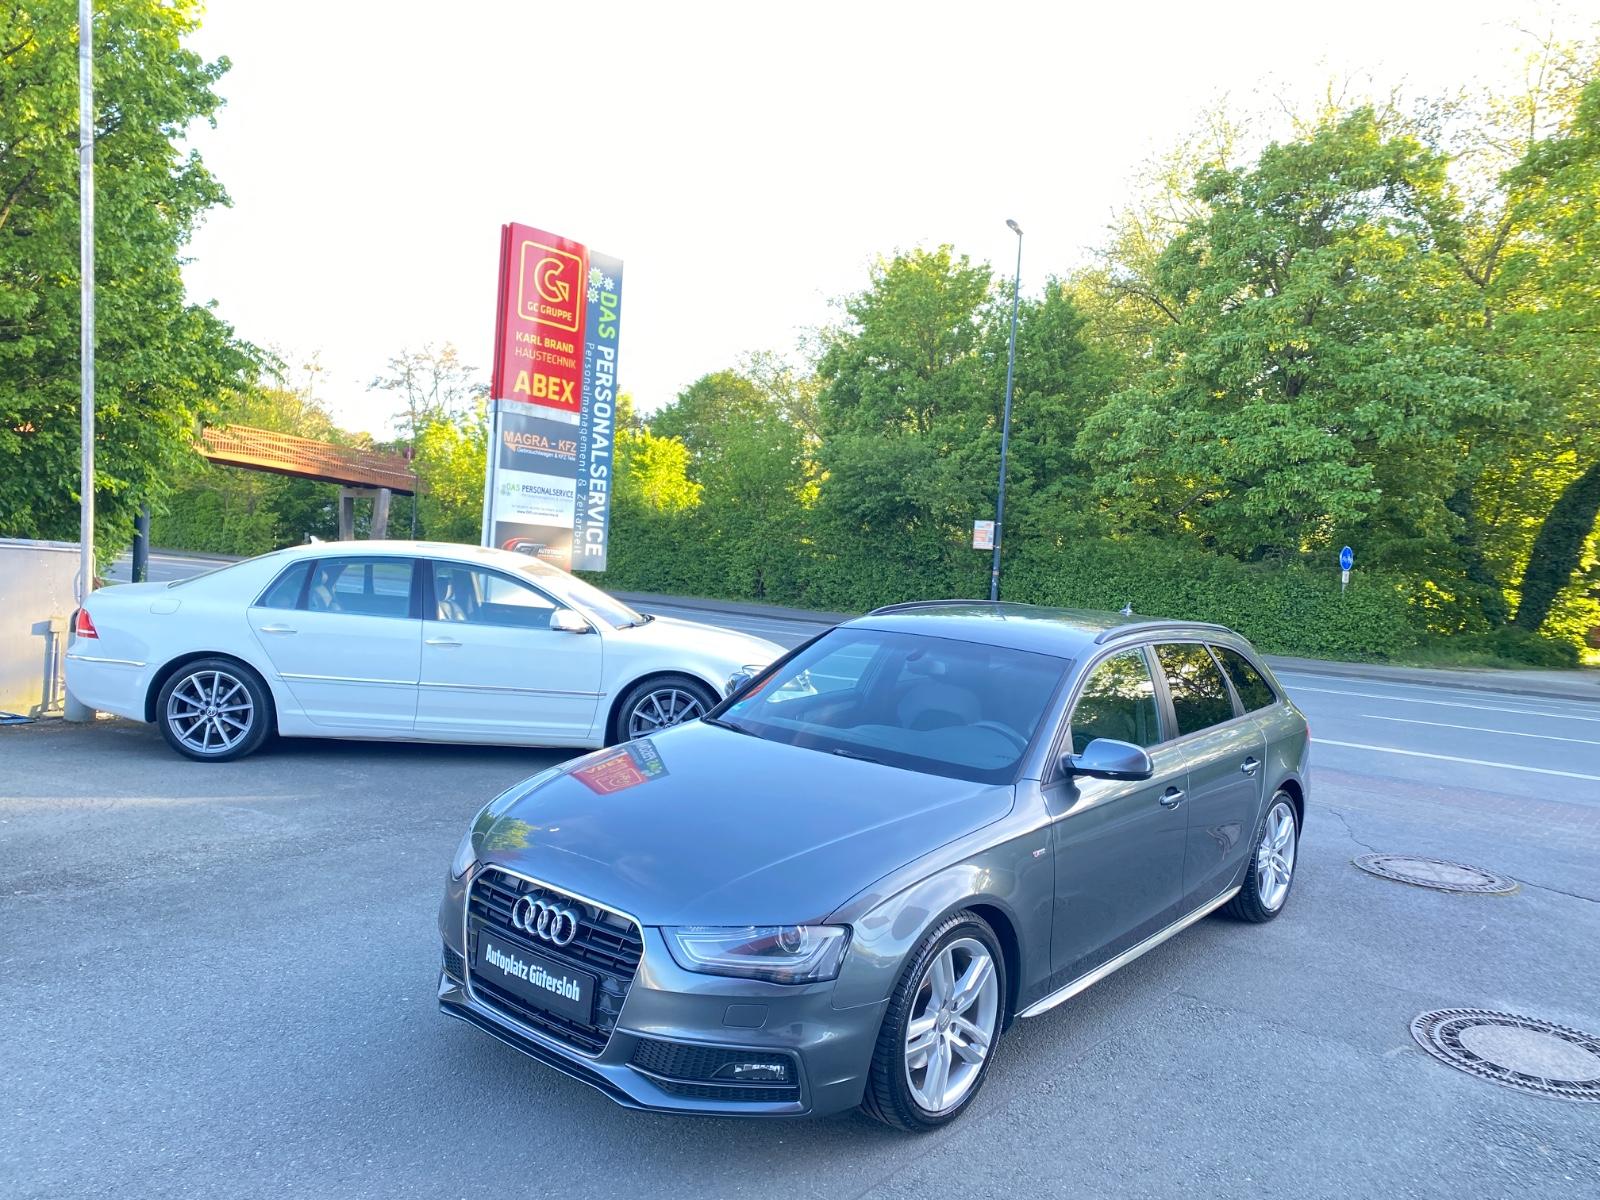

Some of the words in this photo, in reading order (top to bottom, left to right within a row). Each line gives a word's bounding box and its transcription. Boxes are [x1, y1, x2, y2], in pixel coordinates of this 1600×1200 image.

[527, 301, 539, 313] GC
[540, 304, 573, 322] GRUPPE
[598, 291, 618, 339] DAS
[515, 331, 542, 346] KARL
[544, 338, 574, 354] BRAND
[514, 346, 576, 369] HAUSTECHNIK
[513, 369, 575, 404] ABEX
[579, 342, 595, 472] Personalmanagement
[503, 431, 549, 448] MAGRA
[558, 440, 577, 453] KFZ
[585, 345, 615, 556] PERSONALSERVICE
[521, 485, 574, 499] PERSONALSERVICE
[578, 479, 587, 487] &
[574, 494, 586, 555] Zeitarbeit
[486, 943, 529, 981] Autoplatz
[529, 964, 580, 1002] Gütersloh
